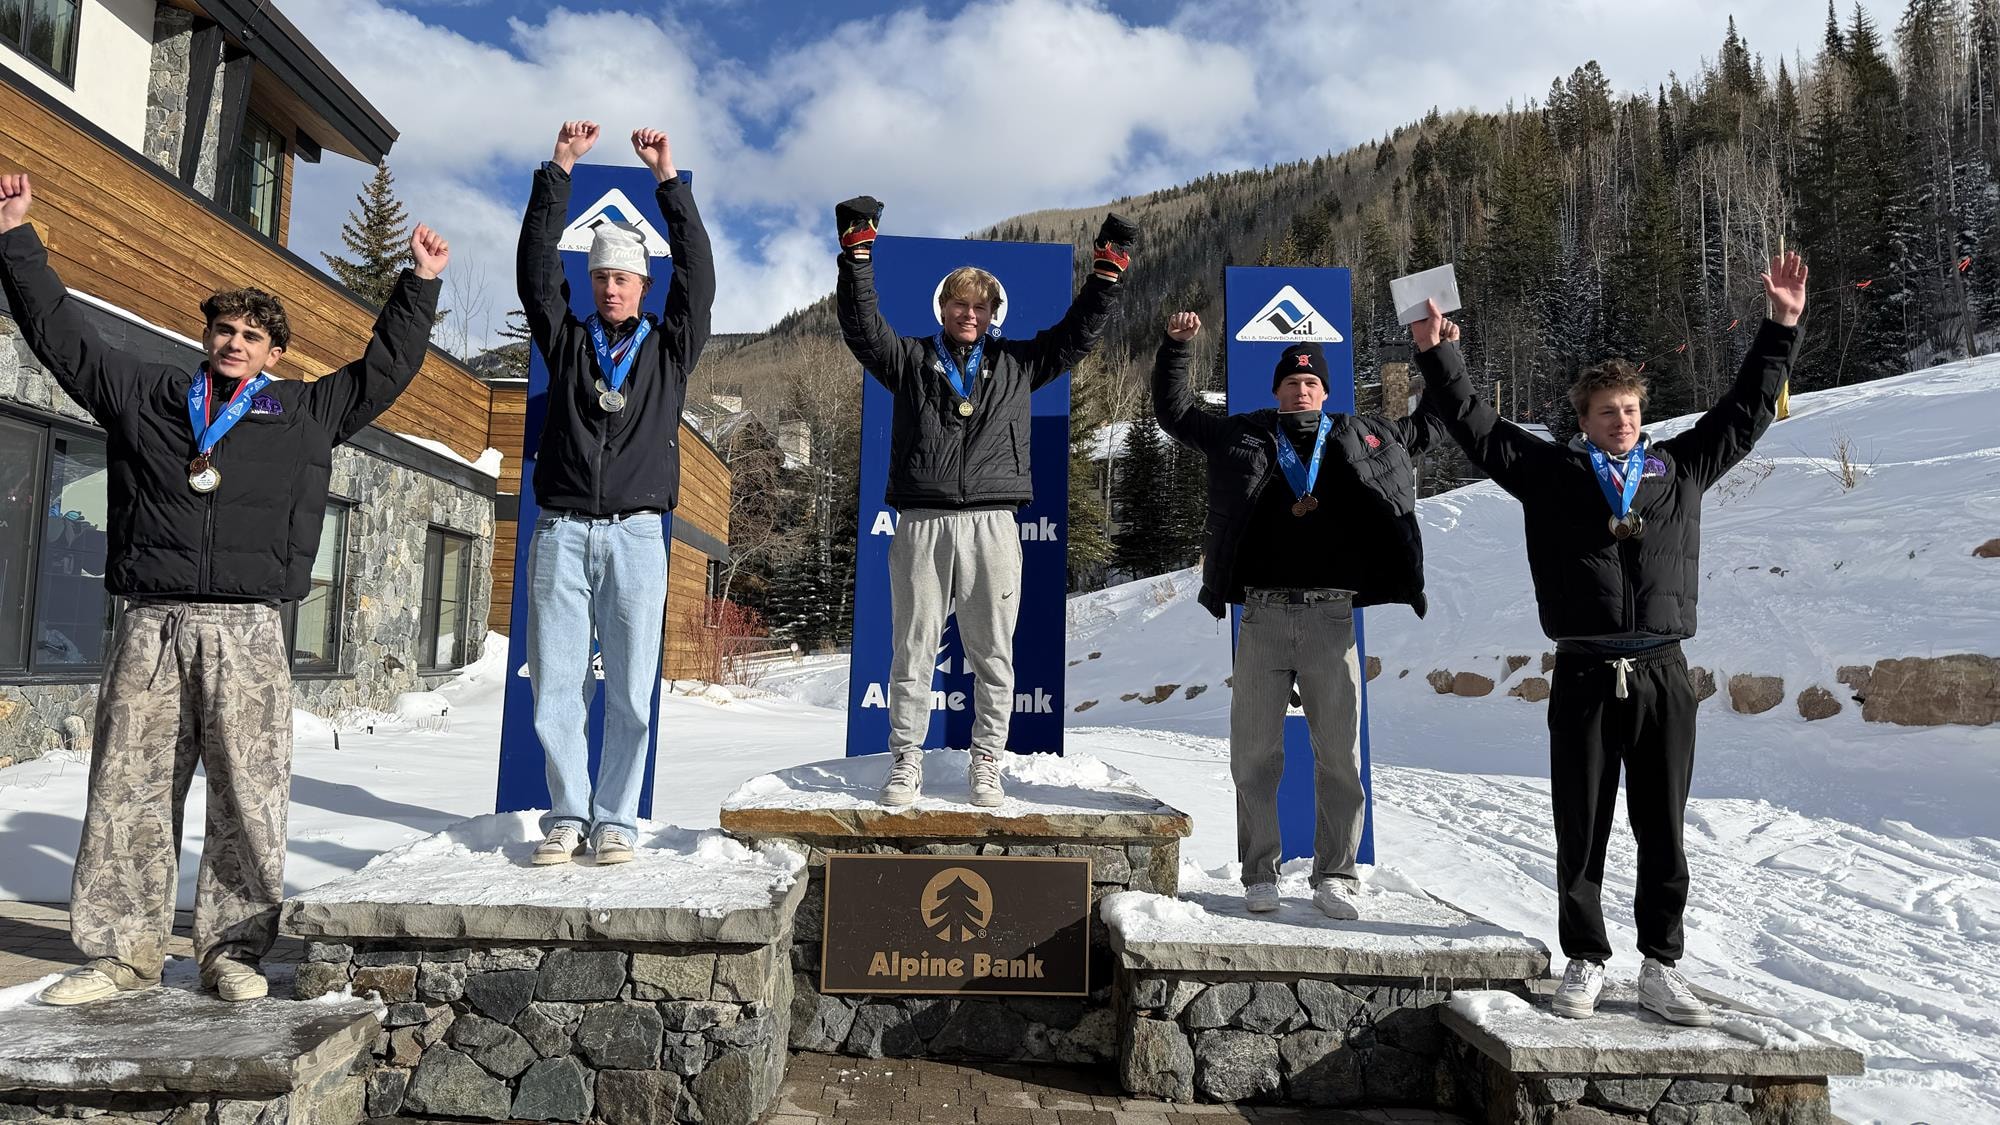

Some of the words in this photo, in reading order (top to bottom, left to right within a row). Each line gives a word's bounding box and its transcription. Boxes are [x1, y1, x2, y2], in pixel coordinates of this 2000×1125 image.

[1016, 516, 1058, 542] nk
[861, 682, 967, 712] Ane
[1014, 687, 1054, 714] nk
[867, 950, 965, 982] Alpine
[973, 952, 1045, 979] Bank
